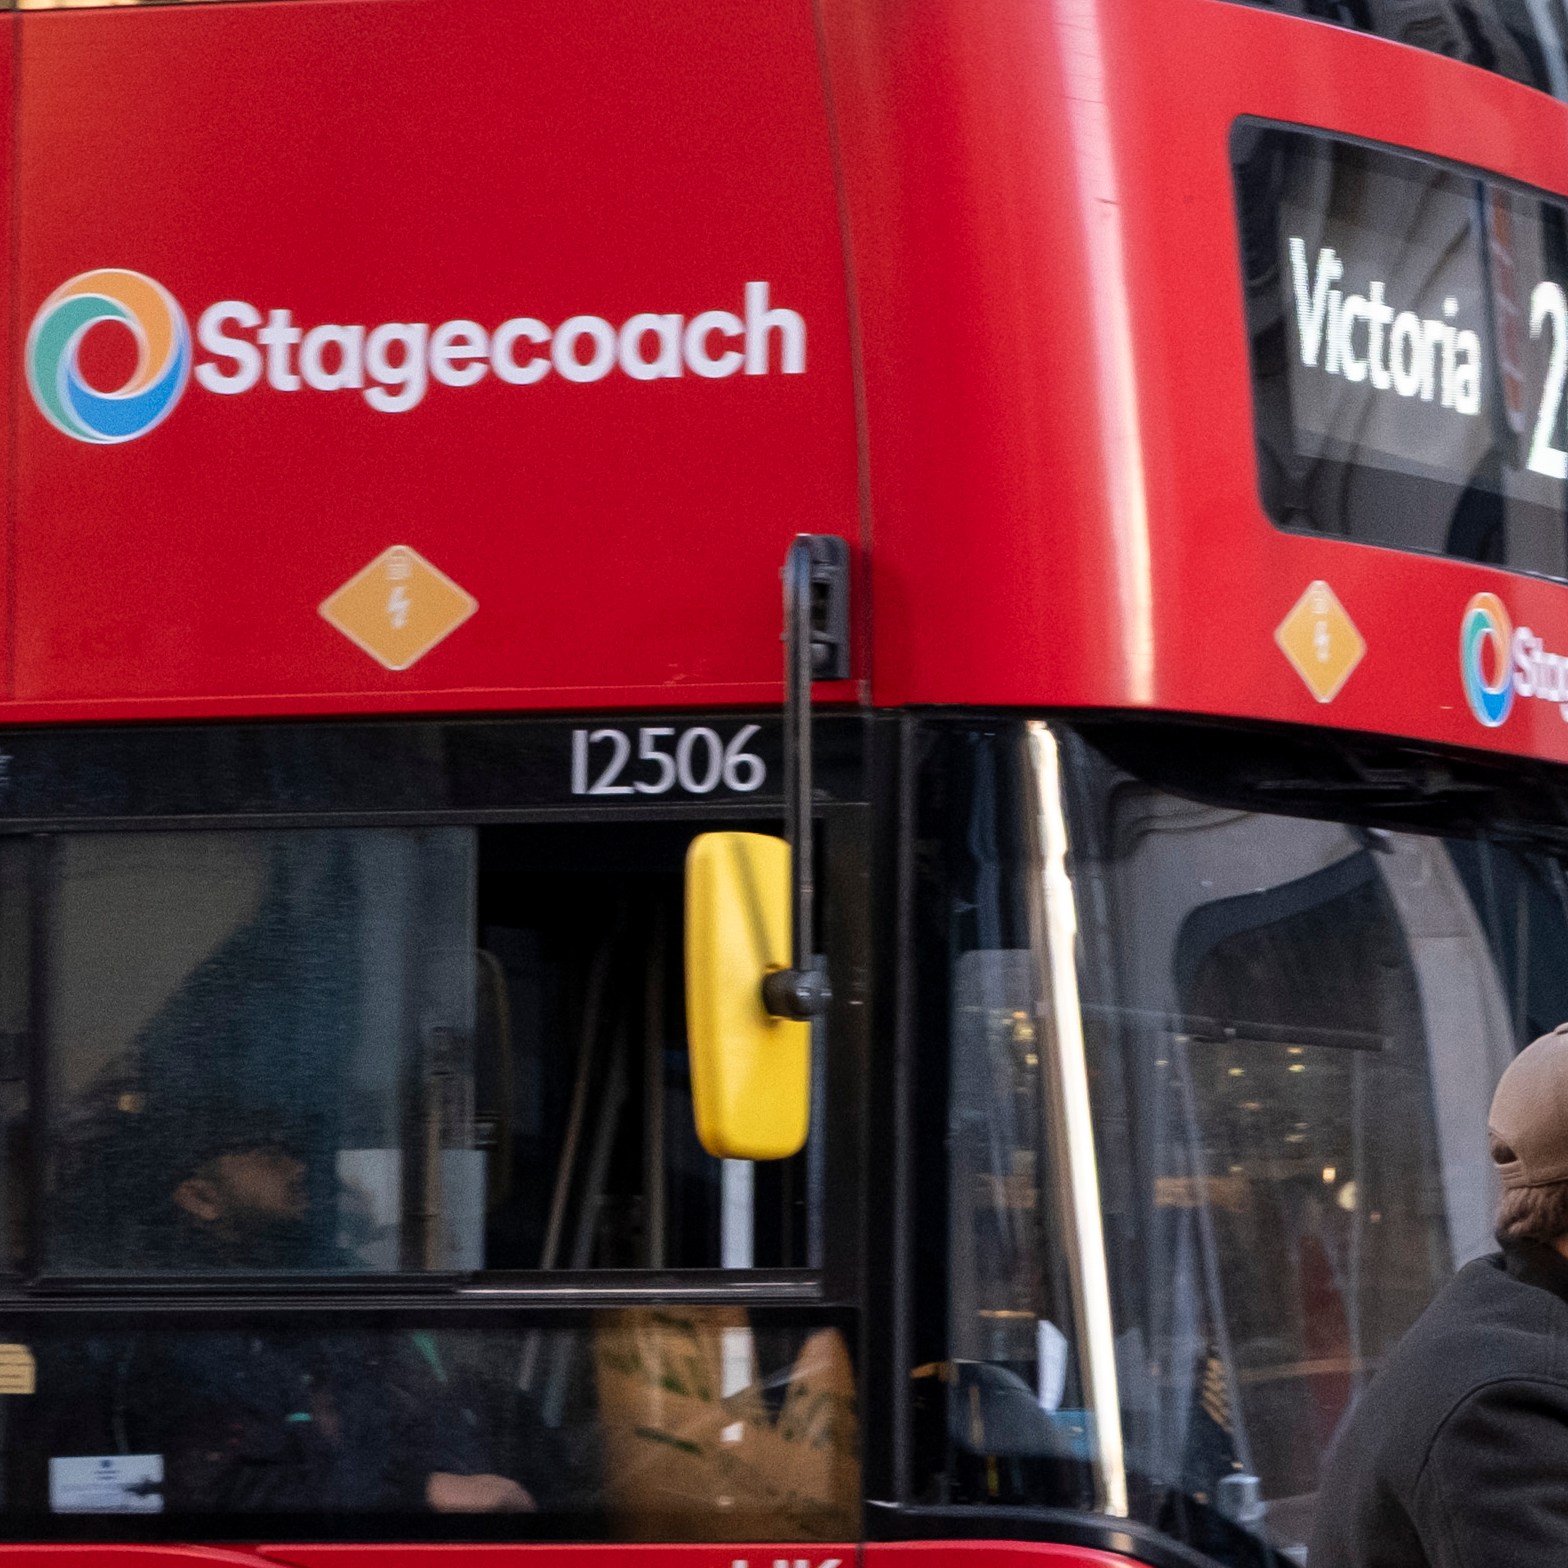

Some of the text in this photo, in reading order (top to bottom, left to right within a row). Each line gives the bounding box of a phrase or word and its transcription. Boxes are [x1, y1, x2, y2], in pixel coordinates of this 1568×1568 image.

[194, 281, 807, 414] Stagecoach
[1288, 237, 1484, 417] Victoria
[570, 725, 767, 796] 12506
